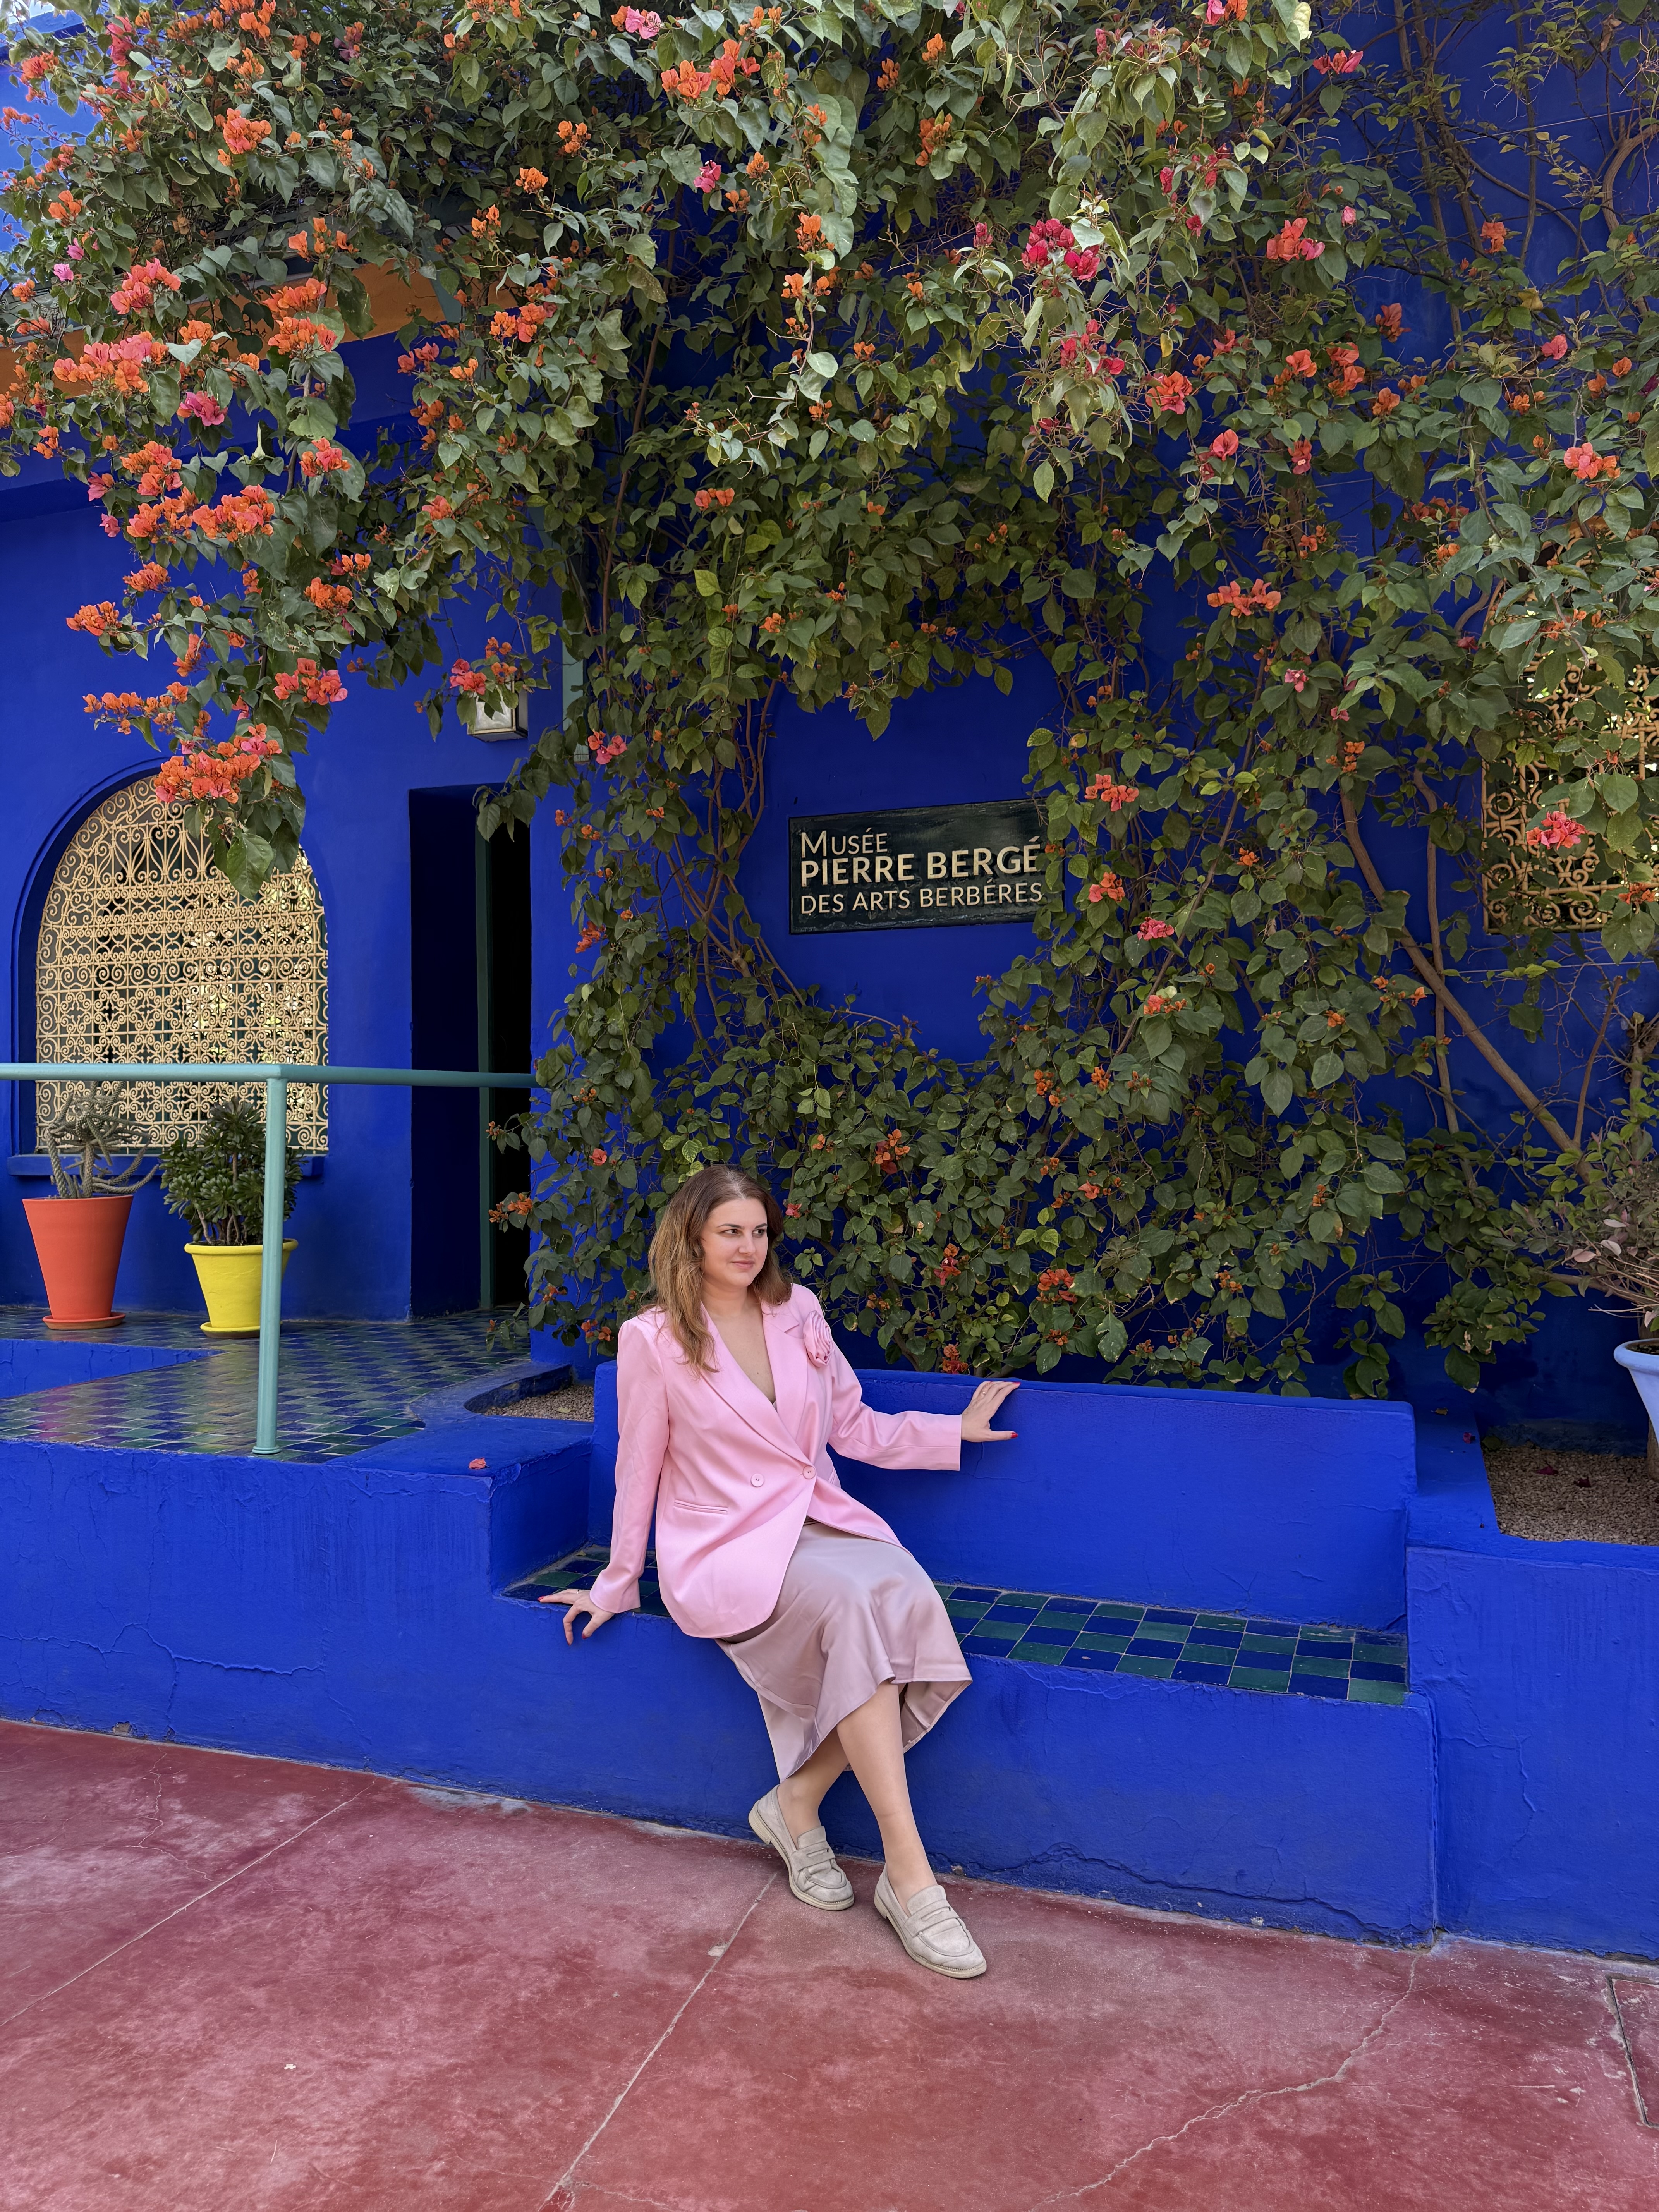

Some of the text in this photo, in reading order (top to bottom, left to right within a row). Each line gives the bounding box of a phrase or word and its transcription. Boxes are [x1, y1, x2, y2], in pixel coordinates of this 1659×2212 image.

[801, 836, 1041, 887] PIERRE BERGÉ
[801, 878, 1042, 914] DES ARTS BERBÉRES
